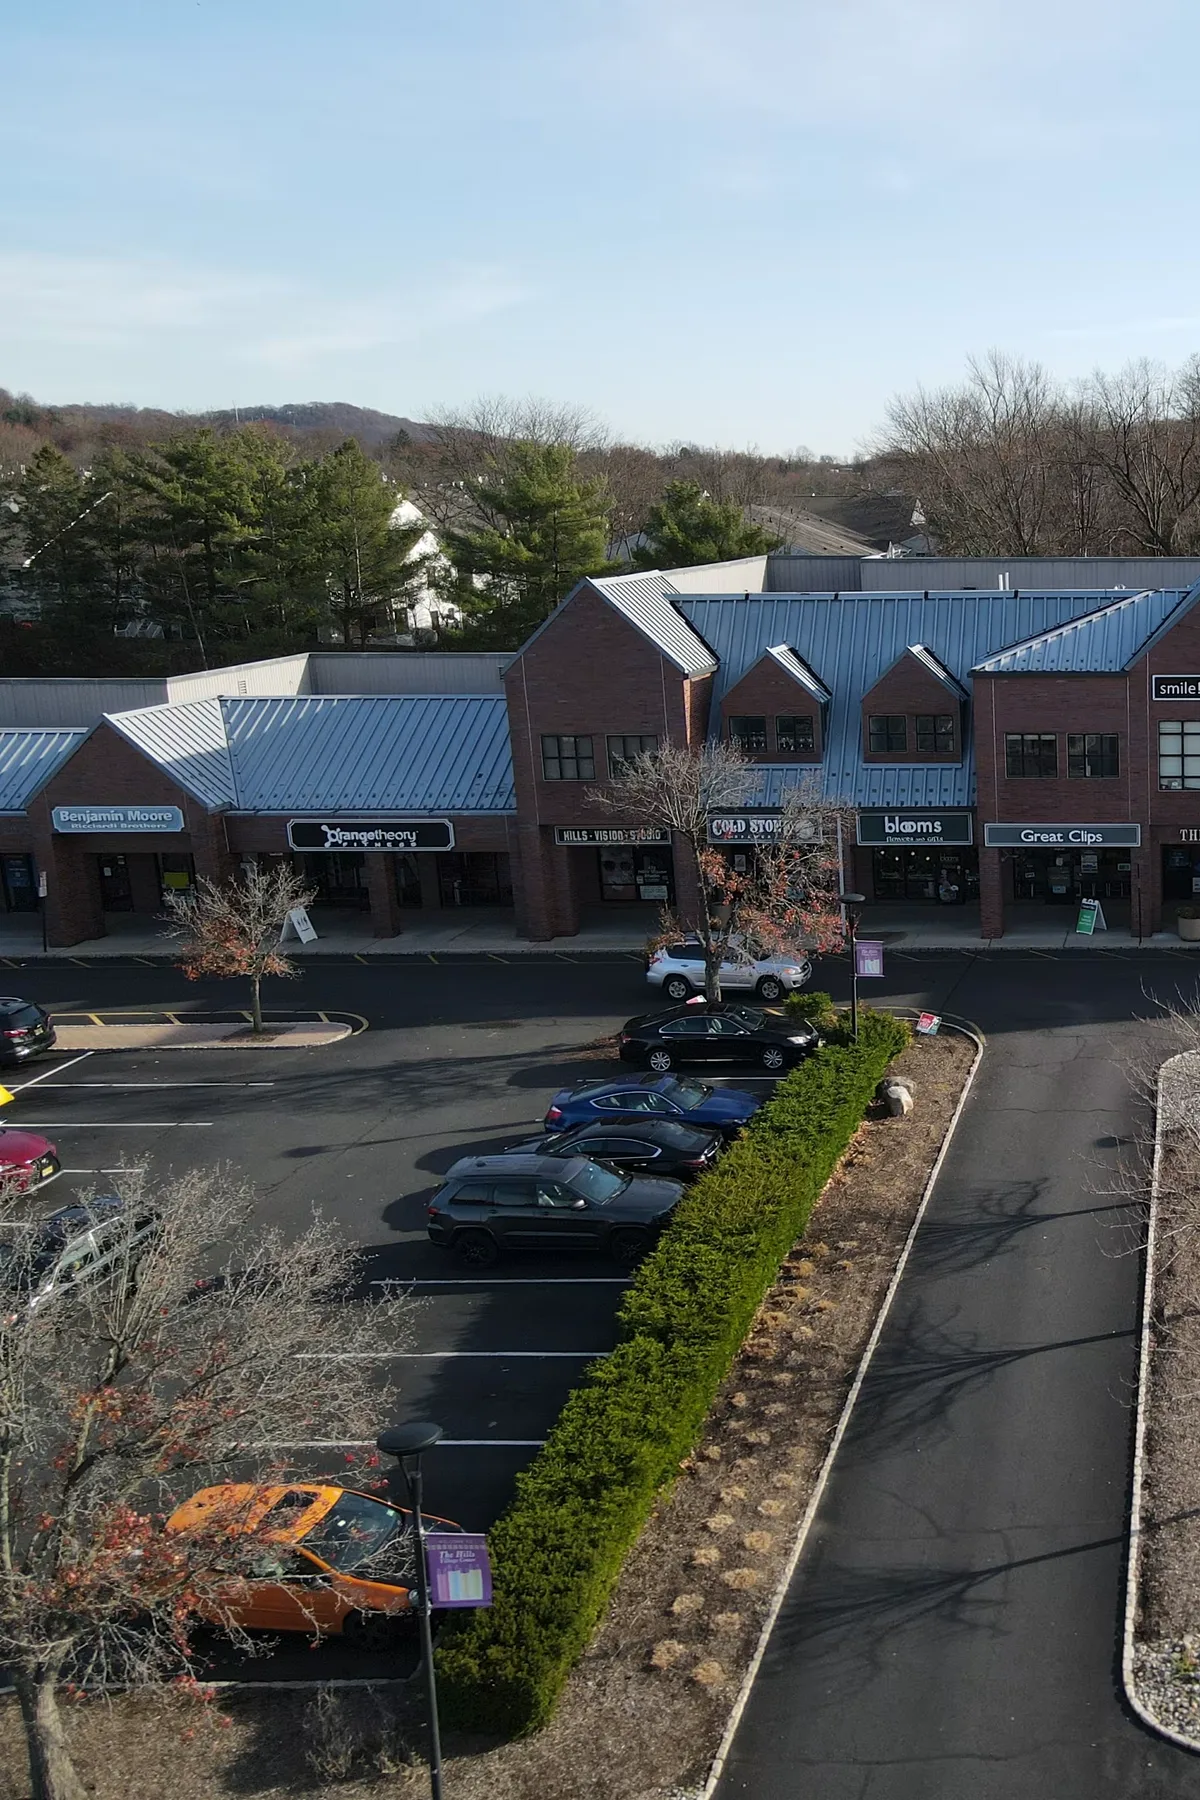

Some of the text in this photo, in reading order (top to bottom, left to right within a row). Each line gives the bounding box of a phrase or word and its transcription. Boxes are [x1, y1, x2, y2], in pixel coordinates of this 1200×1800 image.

[1160, 681, 1200, 694] smile!
[60, 810, 172, 824] Benjamin Moore
[712, 819, 746, 836] COLD
[884, 816, 942, 833] blooms
[563, 830, 588, 841] HILLS
[1020, 830, 1103, 845] Great Clips
